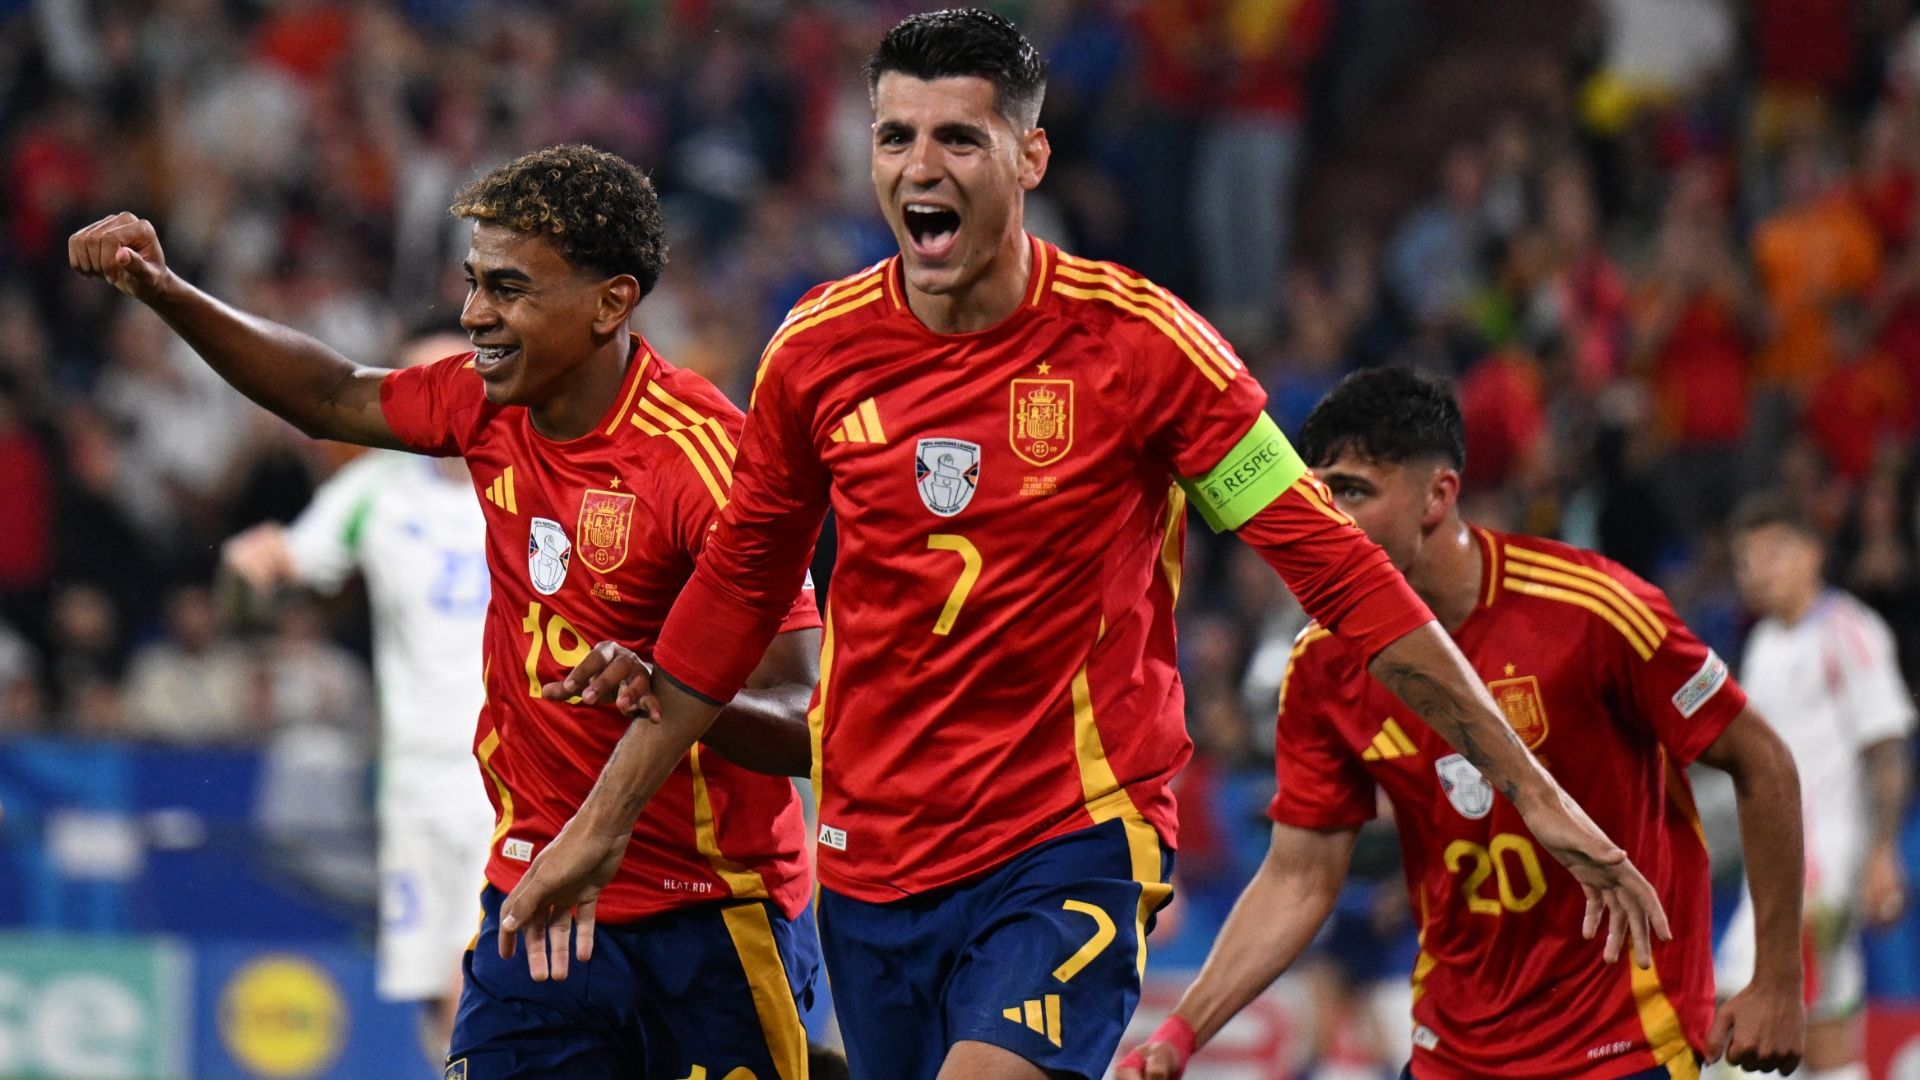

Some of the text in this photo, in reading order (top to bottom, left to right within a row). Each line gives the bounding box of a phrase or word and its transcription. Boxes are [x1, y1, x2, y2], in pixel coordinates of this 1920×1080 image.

[1223, 439, 1281, 492] RESPEC
[926, 533, 983, 636] 7
[522, 601, 591, 705] 19
[663, 878, 713, 894] HEAT.RDY
[1444, 832, 1548, 917] 20
[1051, 898, 1117, 984] 7
